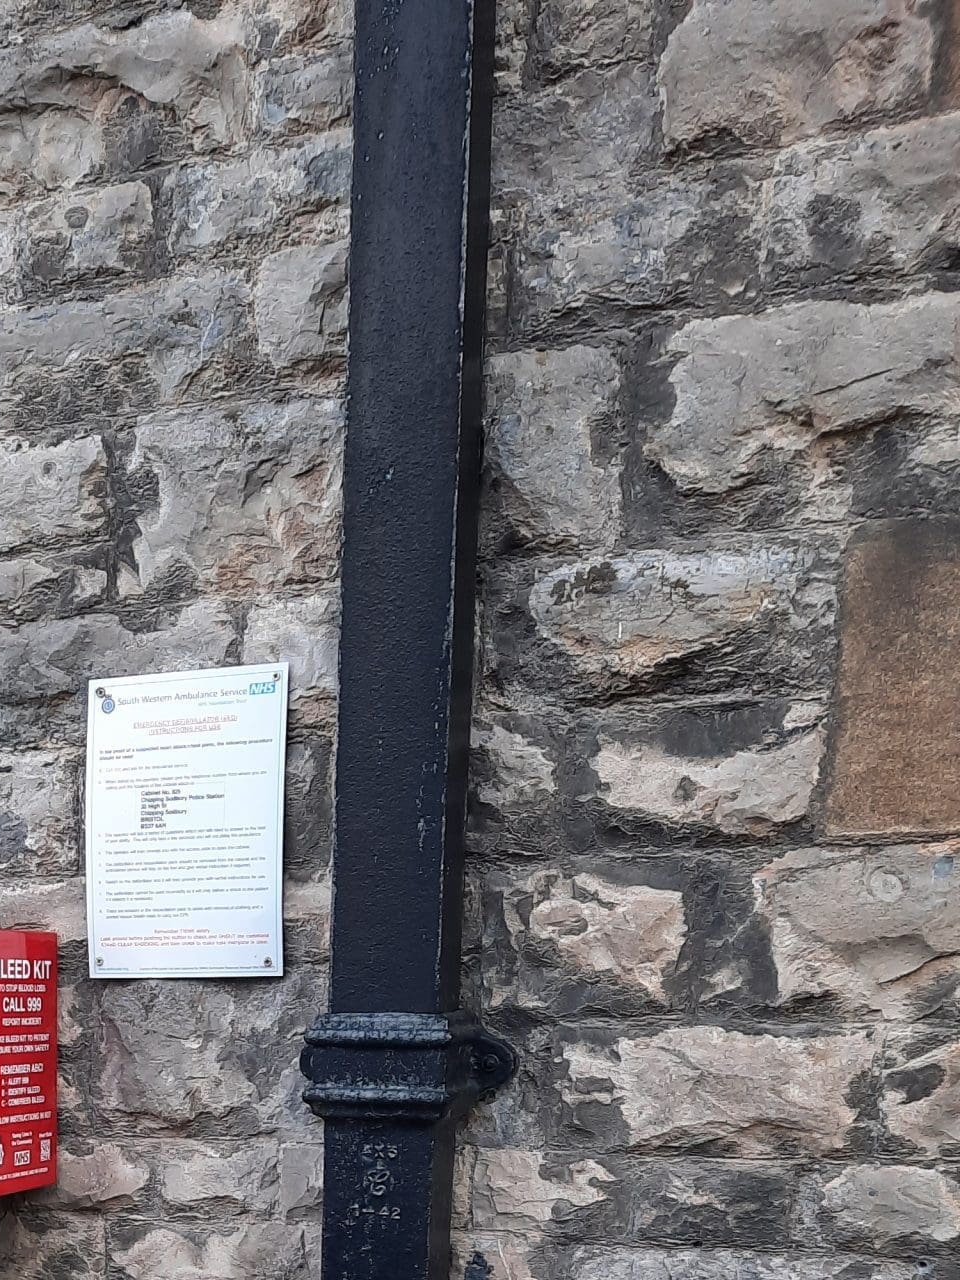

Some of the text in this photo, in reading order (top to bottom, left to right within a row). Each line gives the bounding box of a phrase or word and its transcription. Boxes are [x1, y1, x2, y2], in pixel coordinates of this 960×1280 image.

[250, 683, 275, 695] NHS
[118, 688, 248, 706] South Western Ambulance Service
[33, 960, 52, 979] KIT
[3, 997, 42, 1012] CALL 999
[14, 1151, 30, 1165] NHS
